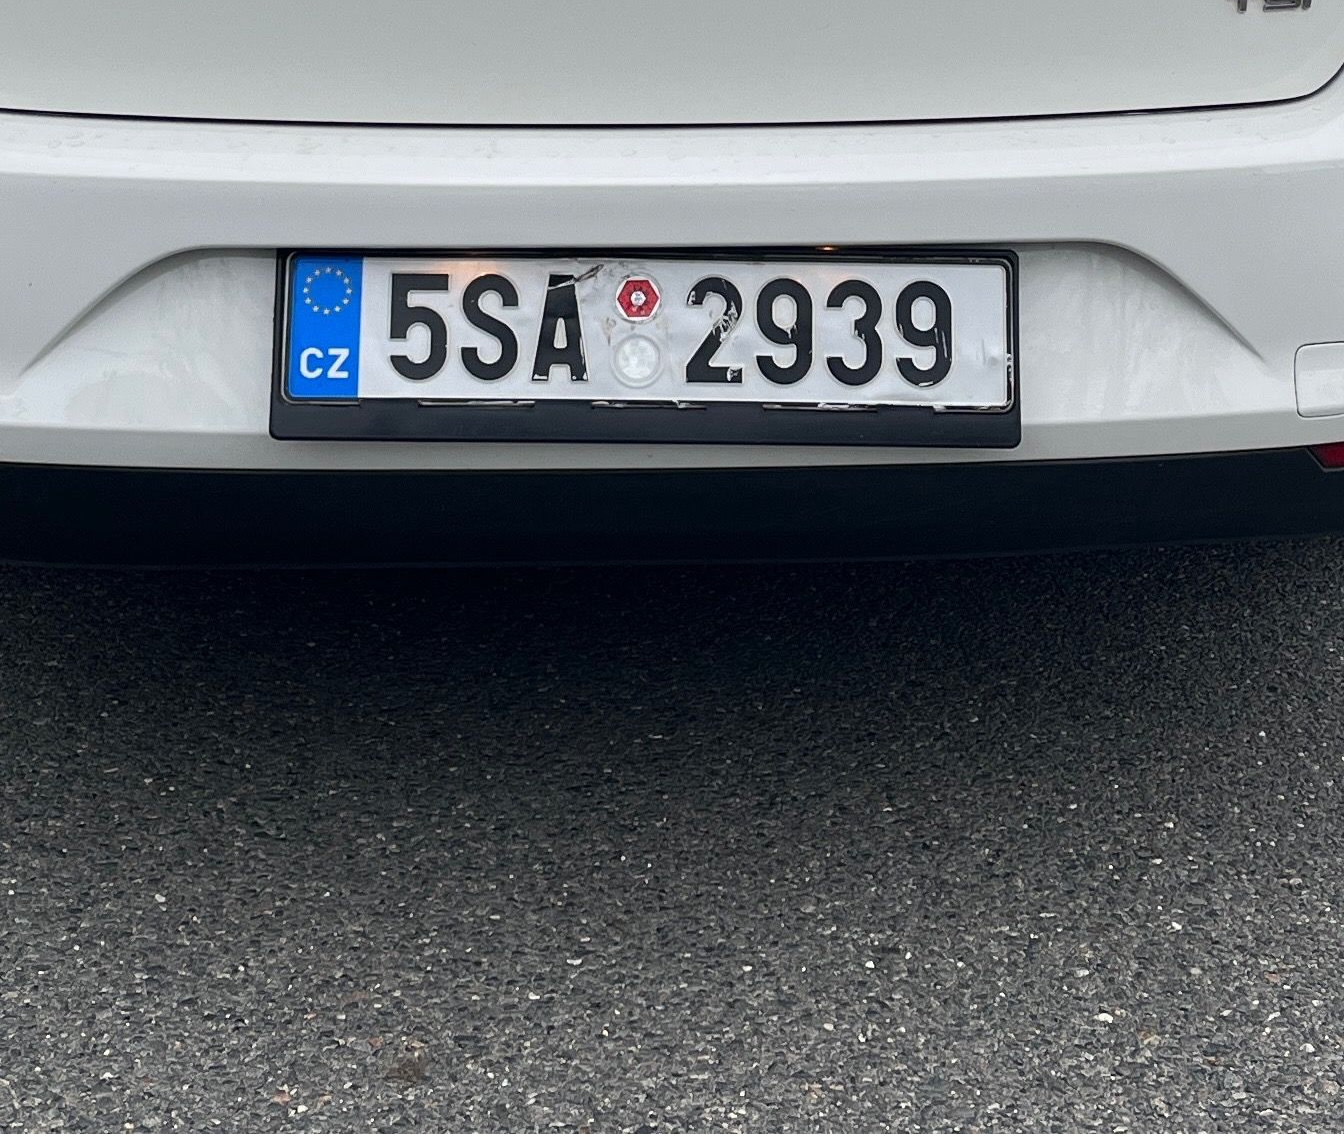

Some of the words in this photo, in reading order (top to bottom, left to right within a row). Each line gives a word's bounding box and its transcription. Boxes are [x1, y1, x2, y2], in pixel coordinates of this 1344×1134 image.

[299, 346, 350, 380] CZ
[389, 273, 588, 382] 5SA
[685, 277, 953, 386] 2939
